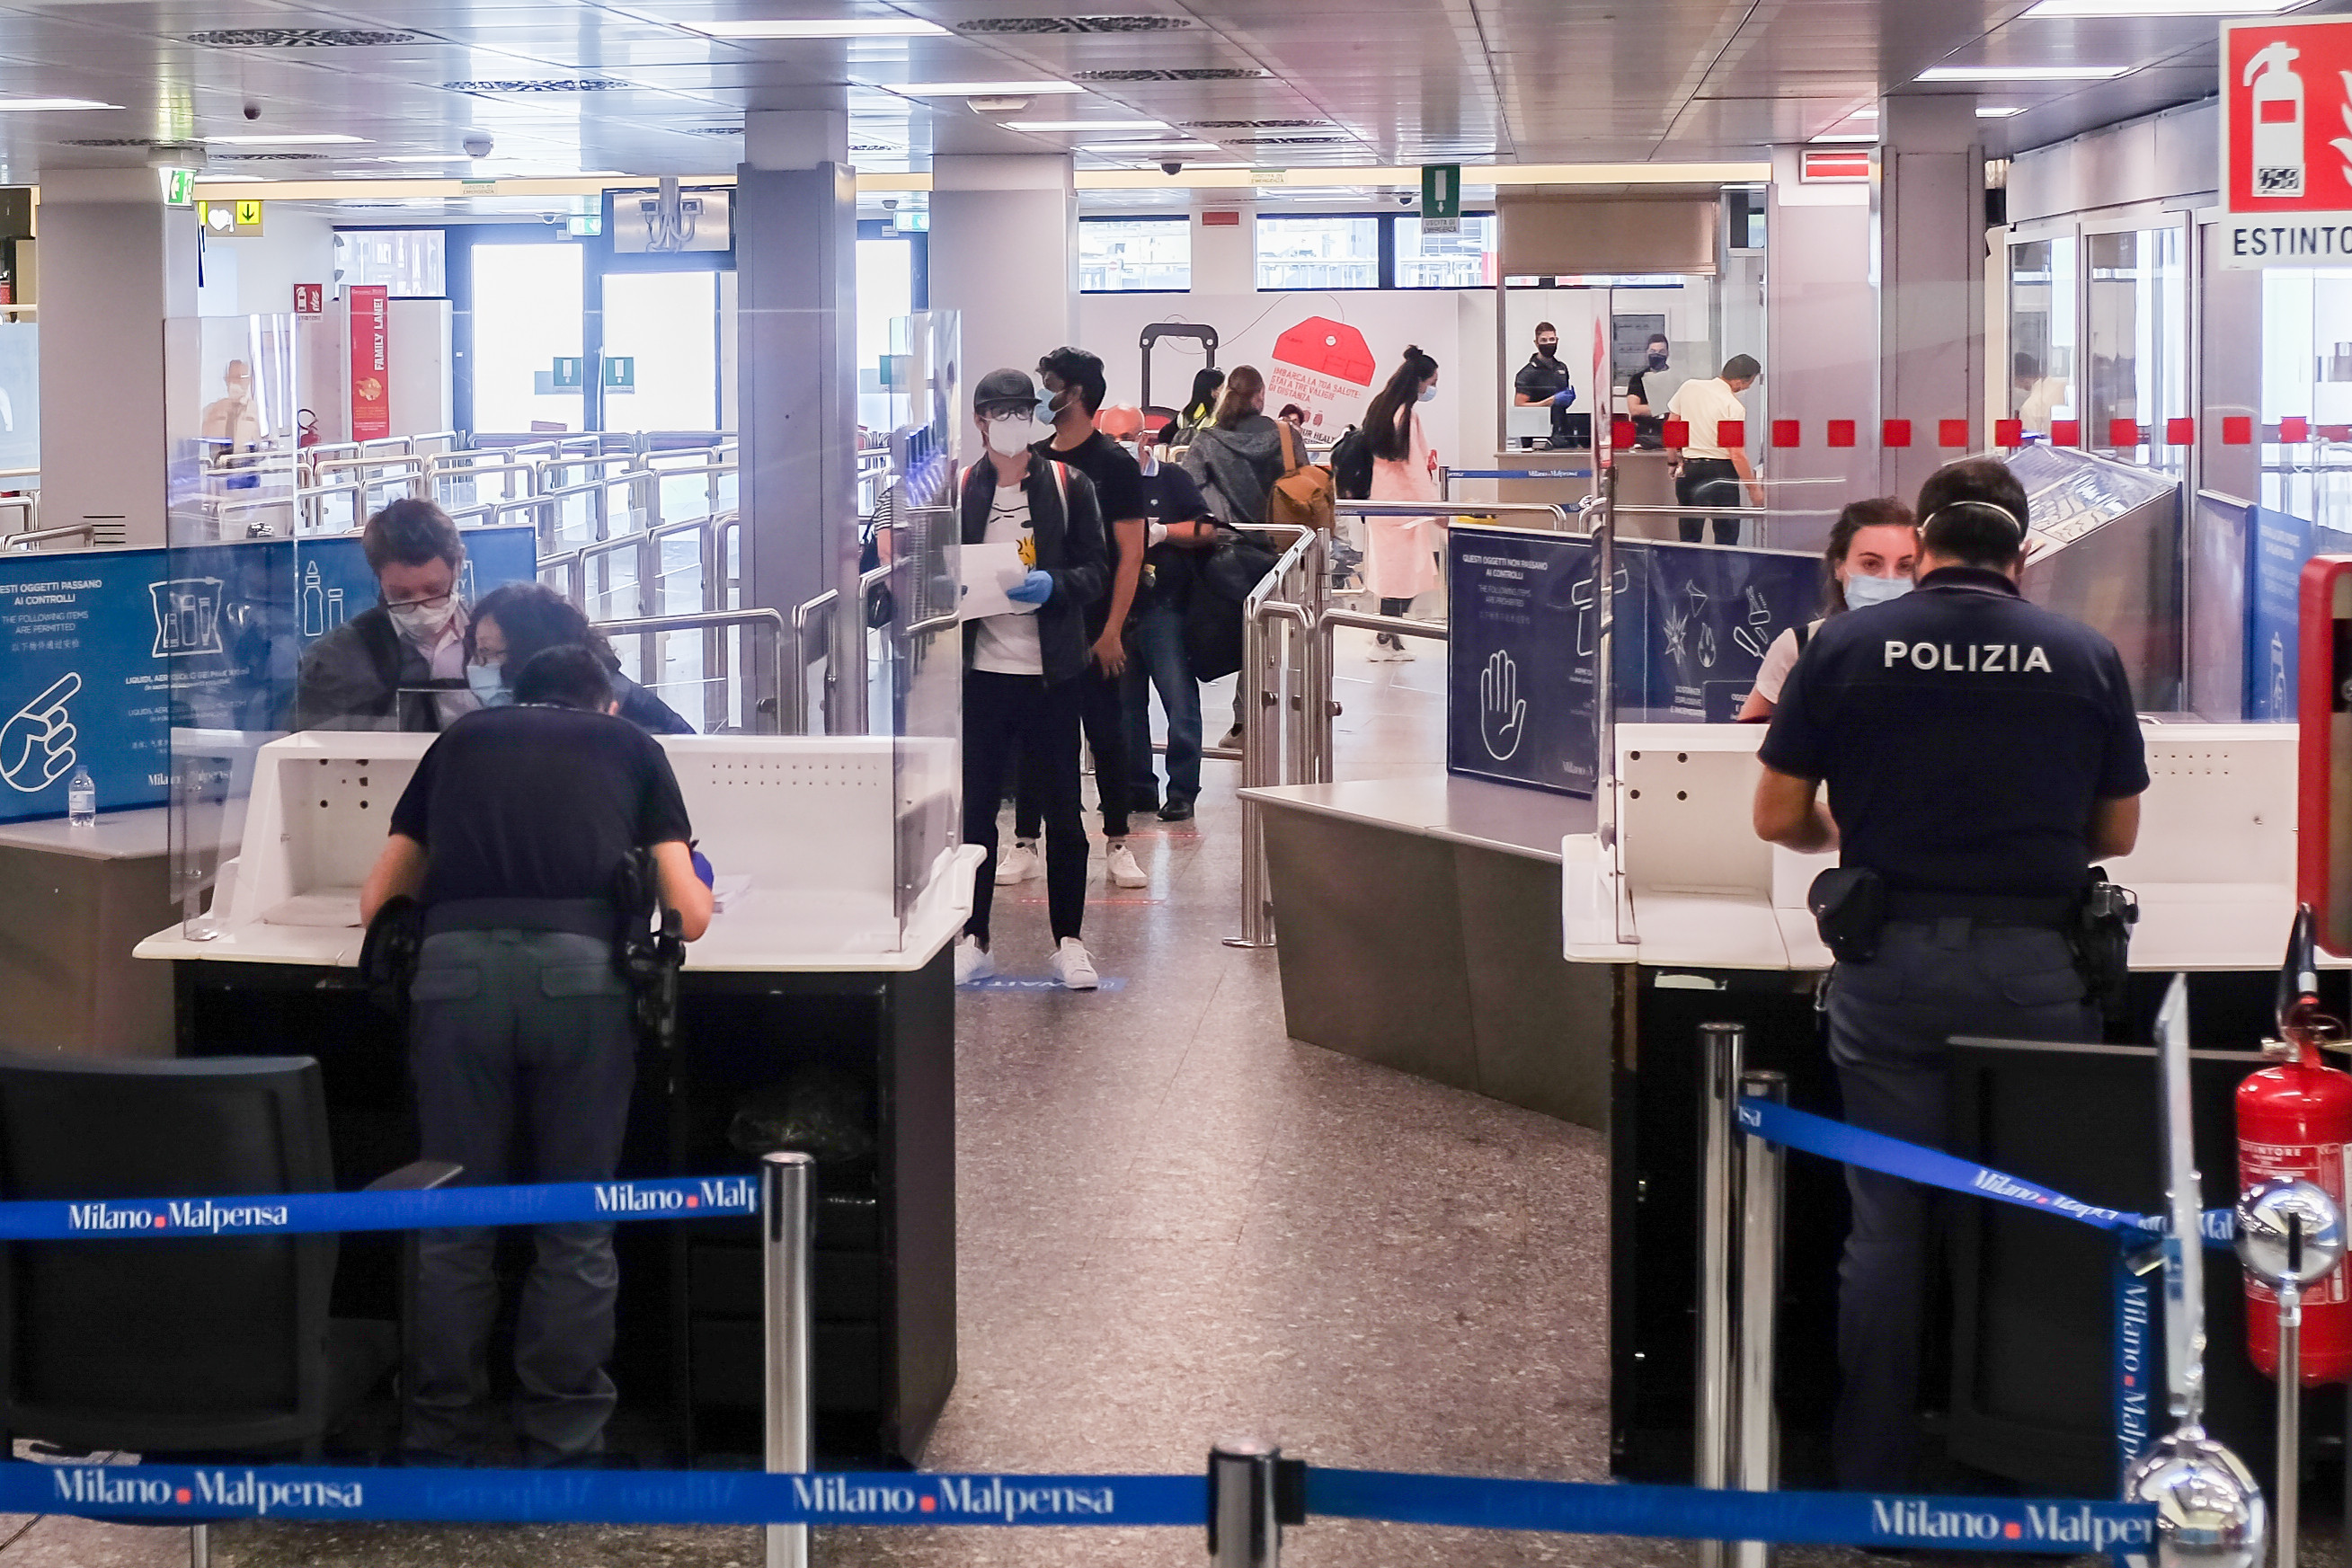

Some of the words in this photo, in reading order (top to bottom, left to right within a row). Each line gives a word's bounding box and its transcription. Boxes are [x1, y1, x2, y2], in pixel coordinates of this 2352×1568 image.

[372, 333, 386, 371] FAMILY
[1270, 375, 1287, 386] STAI
[1286, 379, 1293, 388] A
[1294, 381, 1309, 393] TRE
[1273, 367, 1306, 382] IMBARCA
[1308, 376, 1318, 386] LA
[1276, 385, 1312, 403] DISTANZA
[14, 596, 24, 606] AI
[25, 593, 76, 606] CONTROLLI
[20, 581, 59, 593] OGGETTI
[61, 579, 102, 590] PASSANO
[2, 615, 17, 624] THE
[18, 612, 66, 623] FOLLOWING
[67, 610, 89, 620] ITEMS
[15, 625, 32, 634] ARE
[33, 622, 76, 633] PERMITTED
[1884, 640, 2053, 673] POLIZIA
[595, 1183, 684, 1212] Milano
[1974, 1169, 2041, 1202] Milano
[68, 1202, 153, 1230] Milano
[168, 1200, 288, 1234] Malpensa
[2123, 1283, 2150, 1373] Milano
[53, 1467, 173, 1504] Milano
[195, 1470, 363, 1515] Malpensa
[792, 1476, 915, 1513] Milano
[937, 1476, 1114, 1522] Malpensa
[1871, 1499, 2000, 1539] Milano
